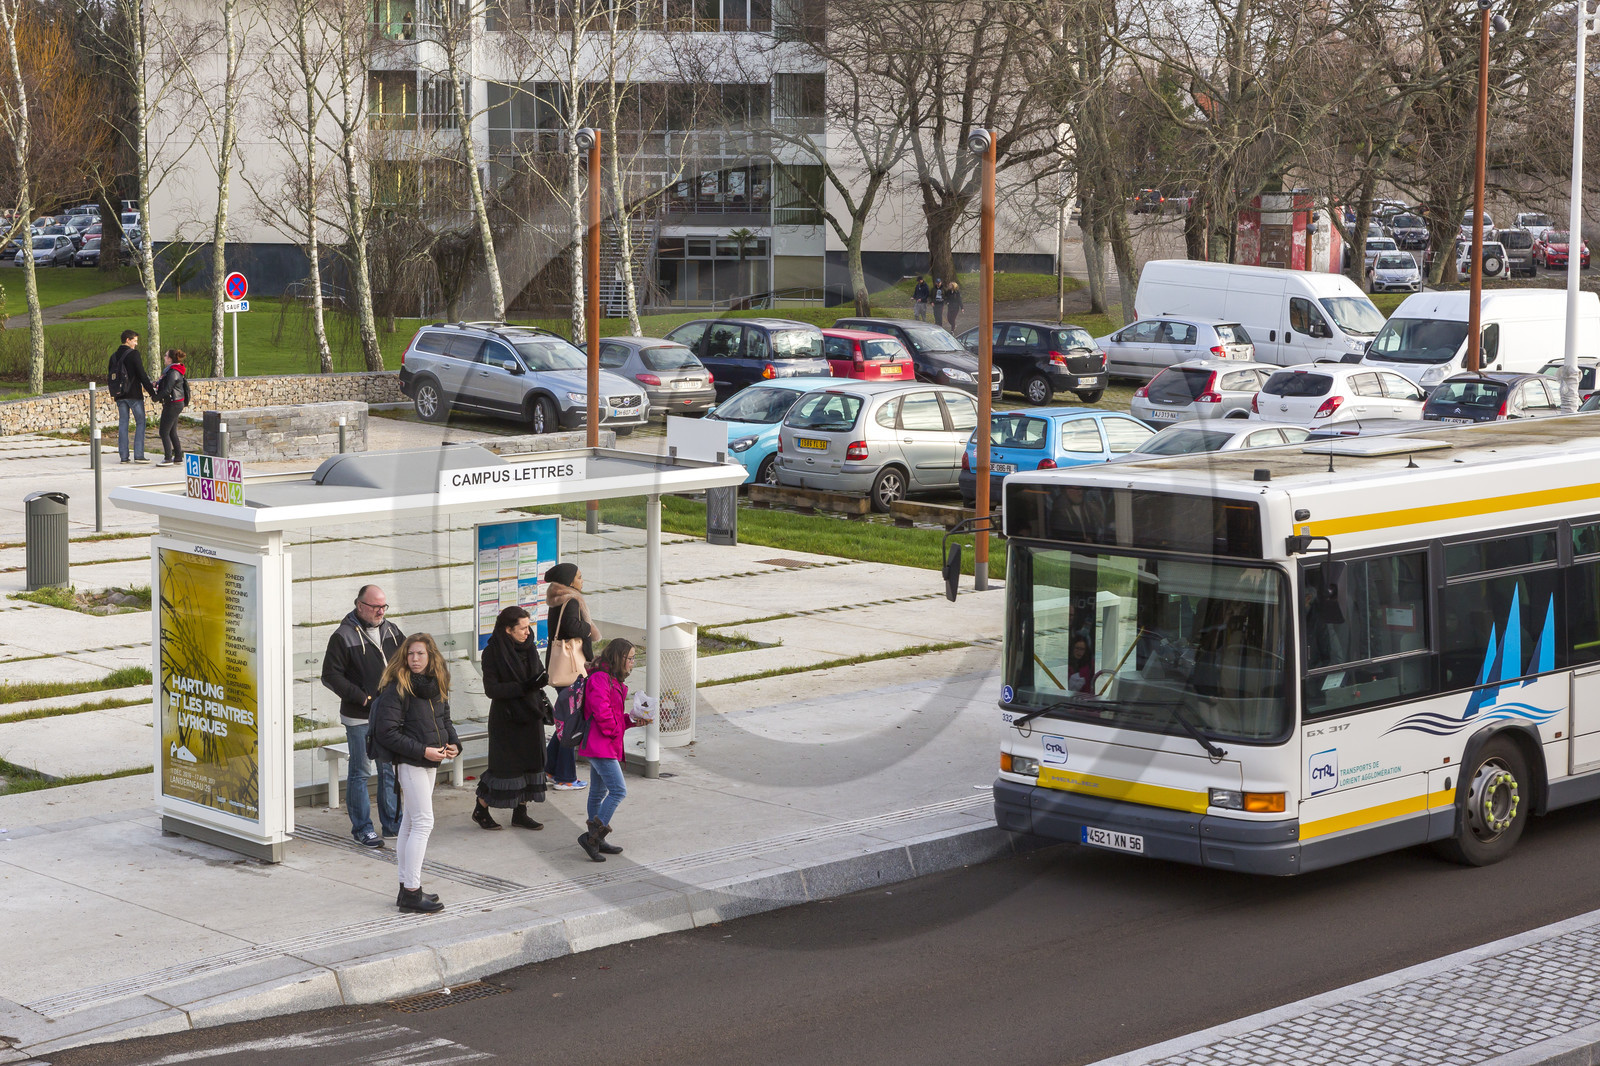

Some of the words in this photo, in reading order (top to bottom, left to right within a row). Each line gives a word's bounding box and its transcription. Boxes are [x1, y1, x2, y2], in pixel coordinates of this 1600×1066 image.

[187, 455, 199, 476] 1a
[203, 457, 211, 478] 4
[214, 460, 227, 480] 21
[228, 461, 241, 481] 22
[452, 470, 511, 487] CAMPUS
[514, 464, 574, 481] LETTRES
[188, 478, 200, 498] 30
[202, 480, 214, 500] 31
[216, 482, 228, 503] 40
[230, 484, 242, 505] 42
[194, 546, 217, 556] JCDecaux
[172, 674, 224, 700] HARTUNG
[169, 691, 181, 707] ET
[183, 695, 203, 713] LES
[204, 700, 254, 726] PEINTRES
[178, 711, 228, 737] LYRIQUES
[1002, 713, 1013, 723] 332
[1306, 728, 1324, 738] GX
[1328, 723, 1351, 733] 317
[1046, 743, 1066, 755] CTRL
[1312, 764, 1335, 780] CTRL
[1340, 762, 1372, 776] TRANSPORTS
[1372, 760, 1380, 769] DE
[170, 775, 204, 790] LANDERNEAU
[1051, 776, 1100, 788] HEULIEZ
[1340, 775, 1361, 787] LORIENT
[1089, 829, 1110, 845] 4521
[1114, 833, 1127, 848] XN
[1129, 836, 1142, 851] 56
